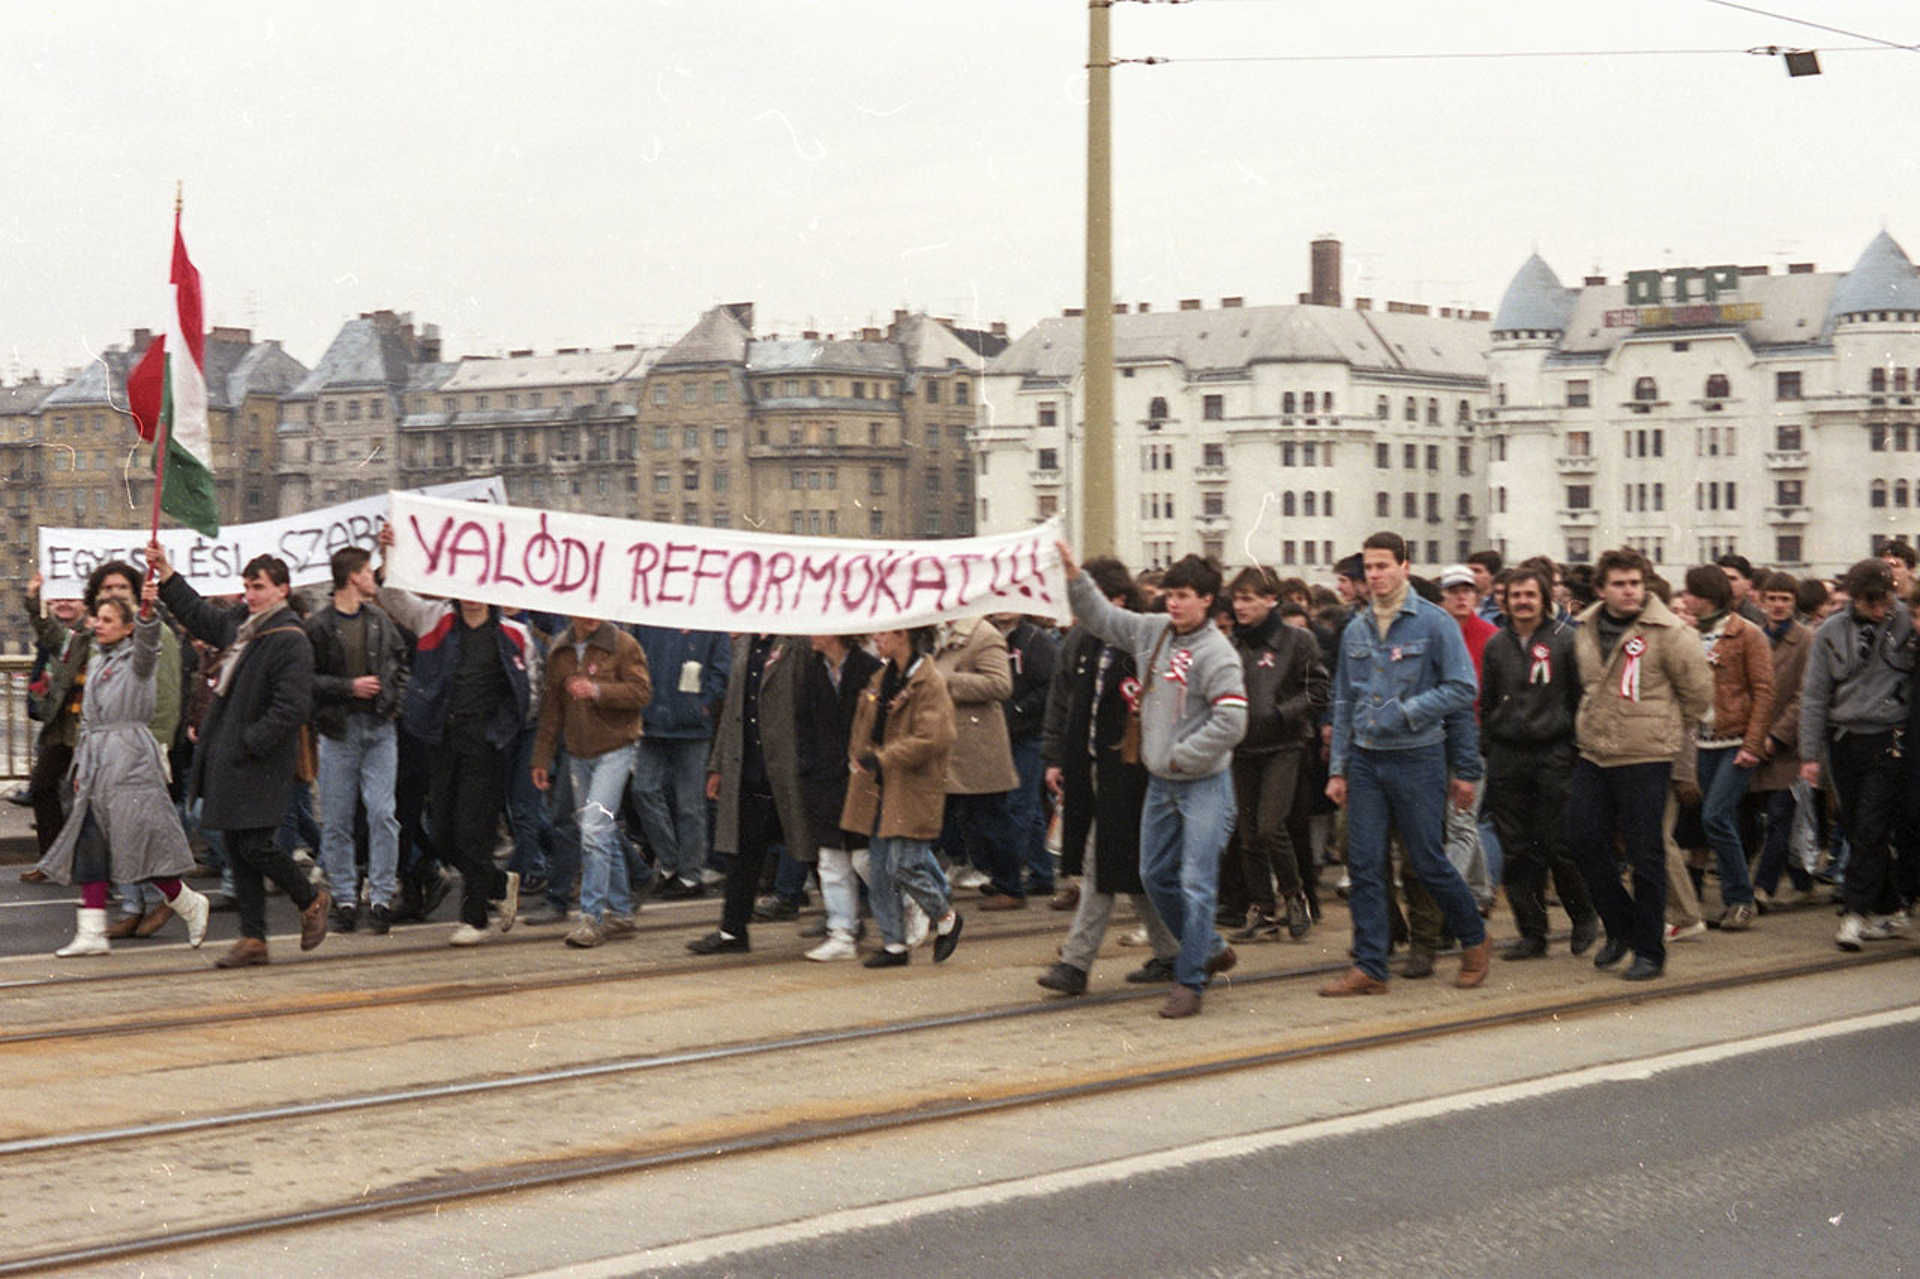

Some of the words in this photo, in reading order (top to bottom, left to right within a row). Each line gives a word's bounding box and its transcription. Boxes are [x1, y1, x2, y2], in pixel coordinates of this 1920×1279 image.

[1627, 265, 1738, 305] OTP
[409, 511, 606, 604] VALÓDI
[627, 540, 1053, 617] REFORMOKAT!!!
